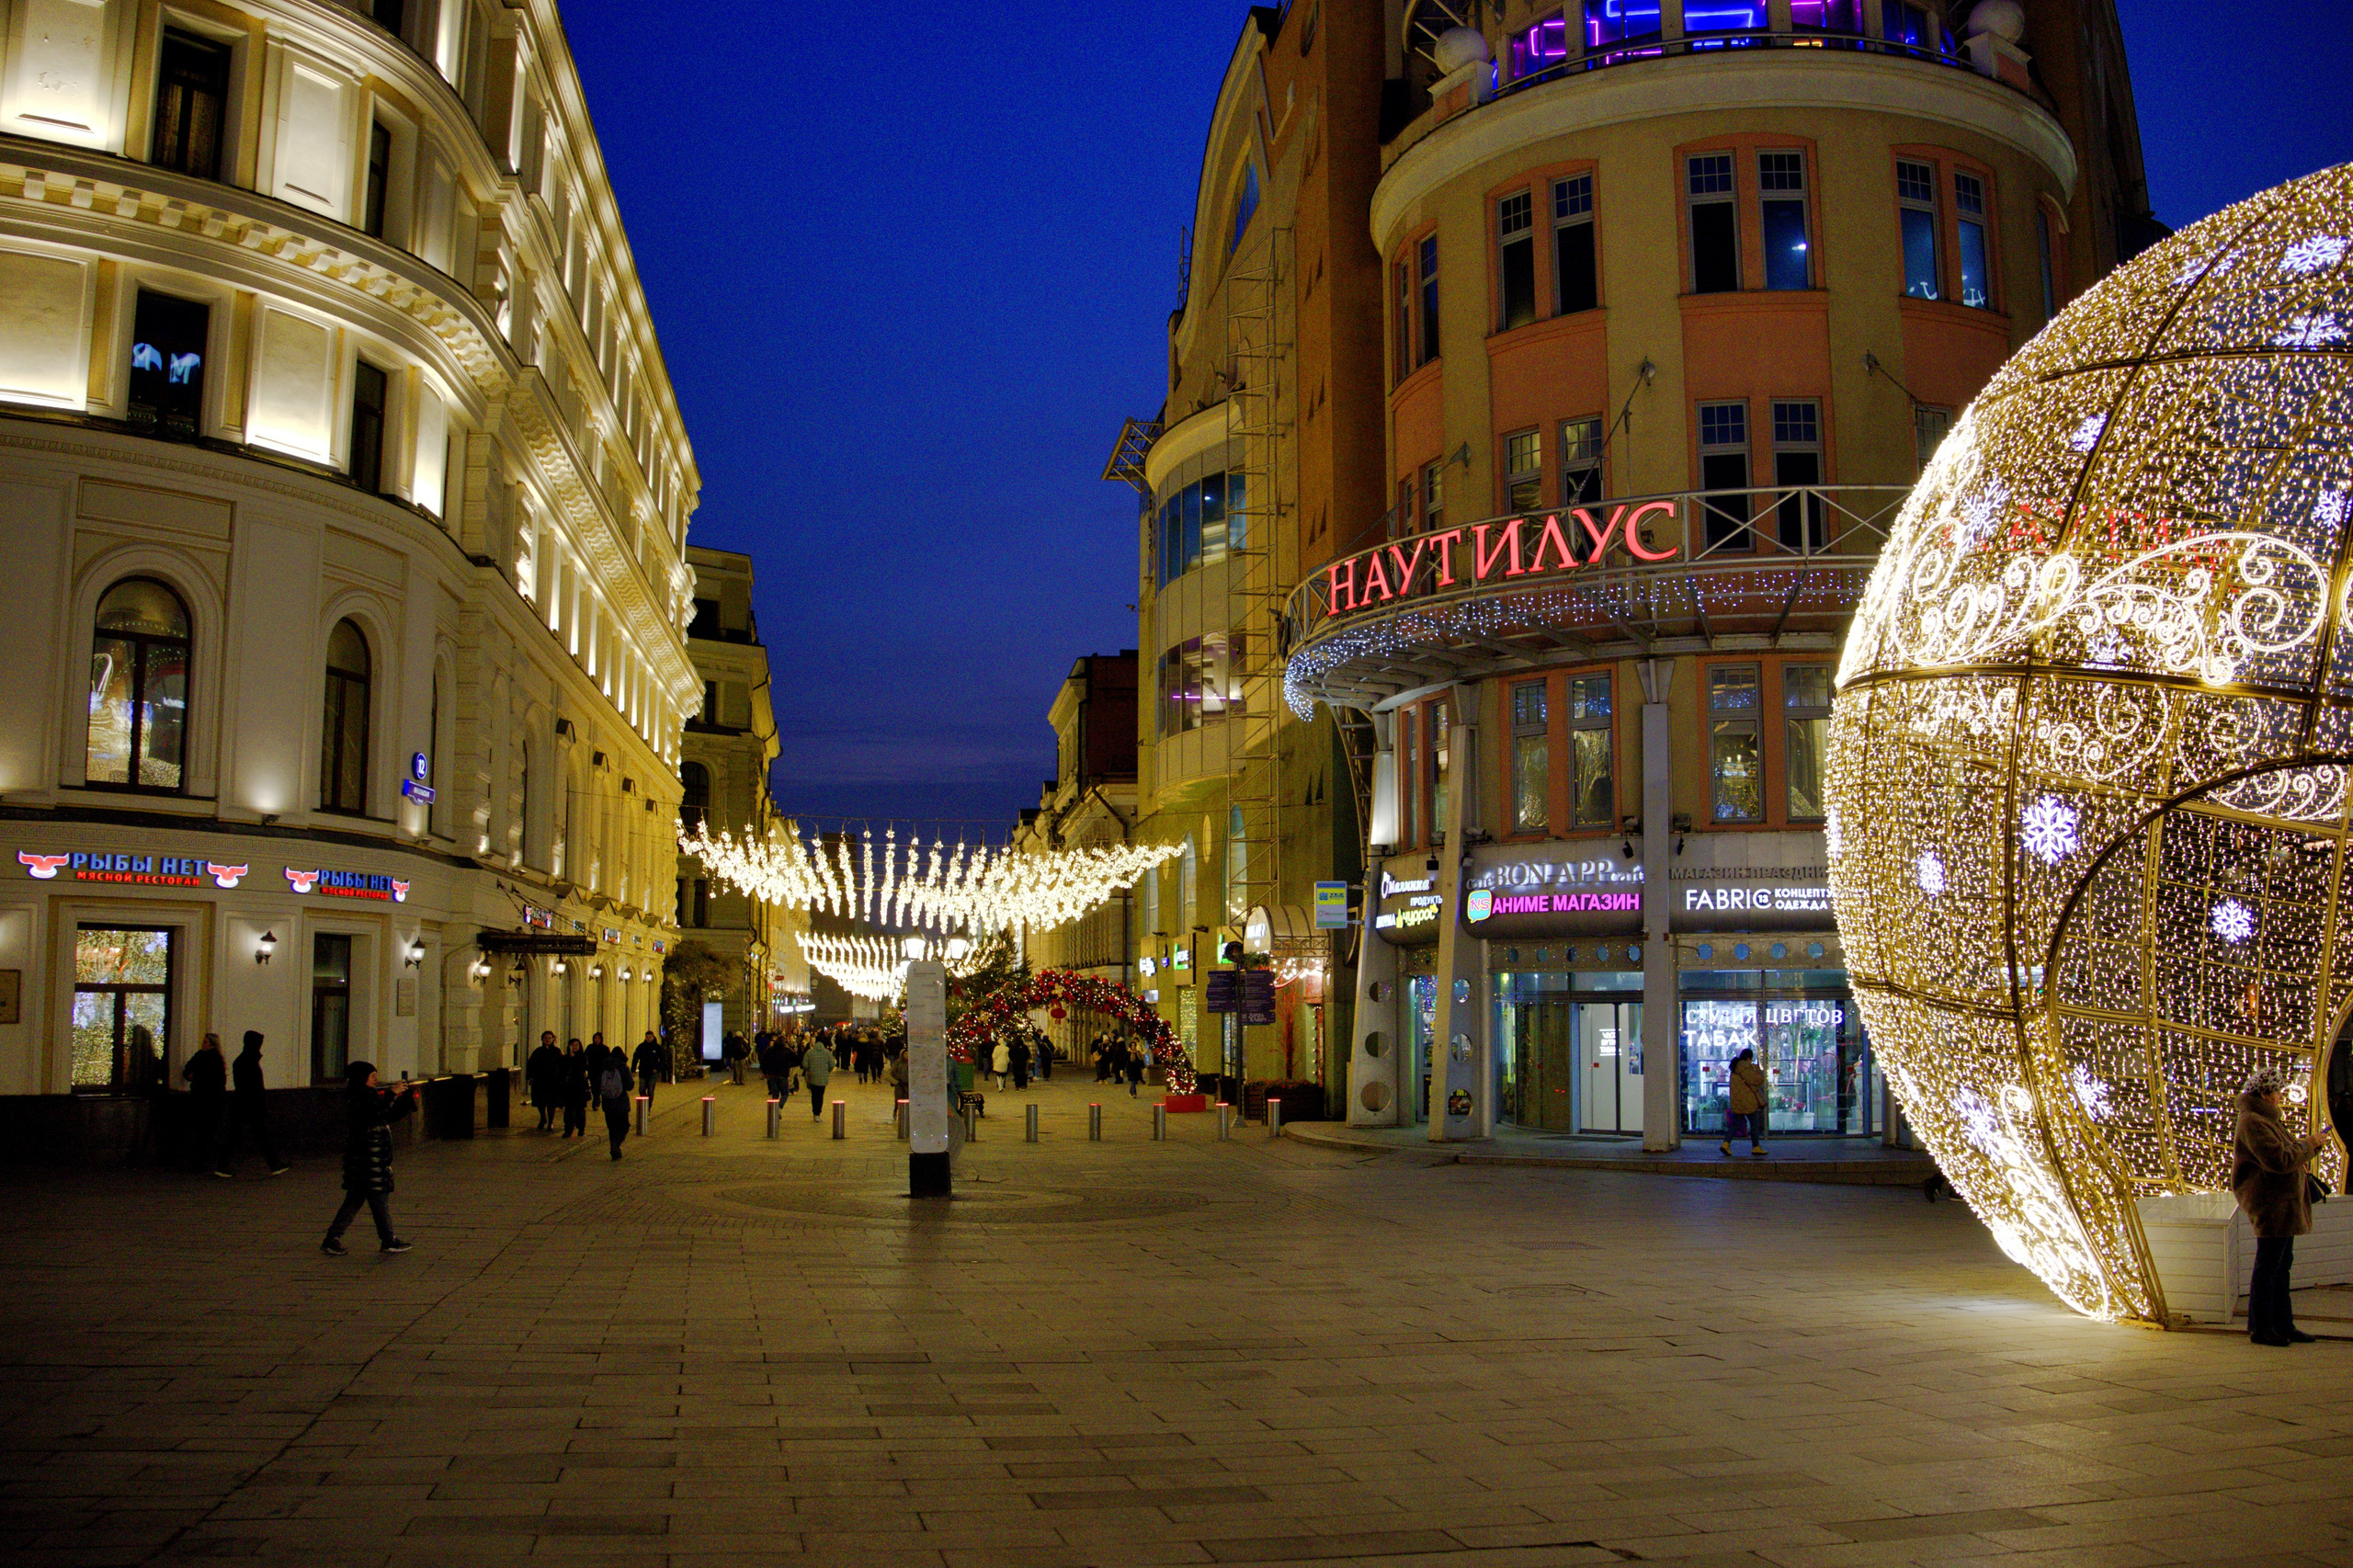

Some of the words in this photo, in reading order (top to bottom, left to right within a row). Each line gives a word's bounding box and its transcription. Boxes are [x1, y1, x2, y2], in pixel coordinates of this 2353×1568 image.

[1327, 502, 1678, 617] НАУТИЛУС
[417, 758, 425, 775] 12
[72, 852, 153, 873] РЫБЫ
[161, 858, 206, 876] НЕТ
[76, 871, 132, 882] МЯСНОЙ
[135, 874, 200, 886] РЕСТОРАН
[320, 869, 366, 888] РЫБЫ
[369, 875, 392, 891] НЕТ
[1495, 862, 1547, 887] BON
[1669, 867, 1746, 880] МАГАЗИН
[1749, 866, 1829, 881] ПРАЗДНИ
[321, 887, 355, 897] МЯСНОЙ
[356, 890, 389, 900] РЕСТОРАН
[1685, 888, 1772, 911] FABRIC
[1774, 888, 1836, 900] КОНЦЕПТУ
[1492, 894, 1550, 915] АНИМЕ
[1552, 892, 1640, 912] МАГАЗИН
[1775, 899, 1828, 911] ОДЕЖДА
[1686, 1008, 1757, 1024] СТУДИЯ
[1683, 1028, 1758, 1047] ТАБАК
